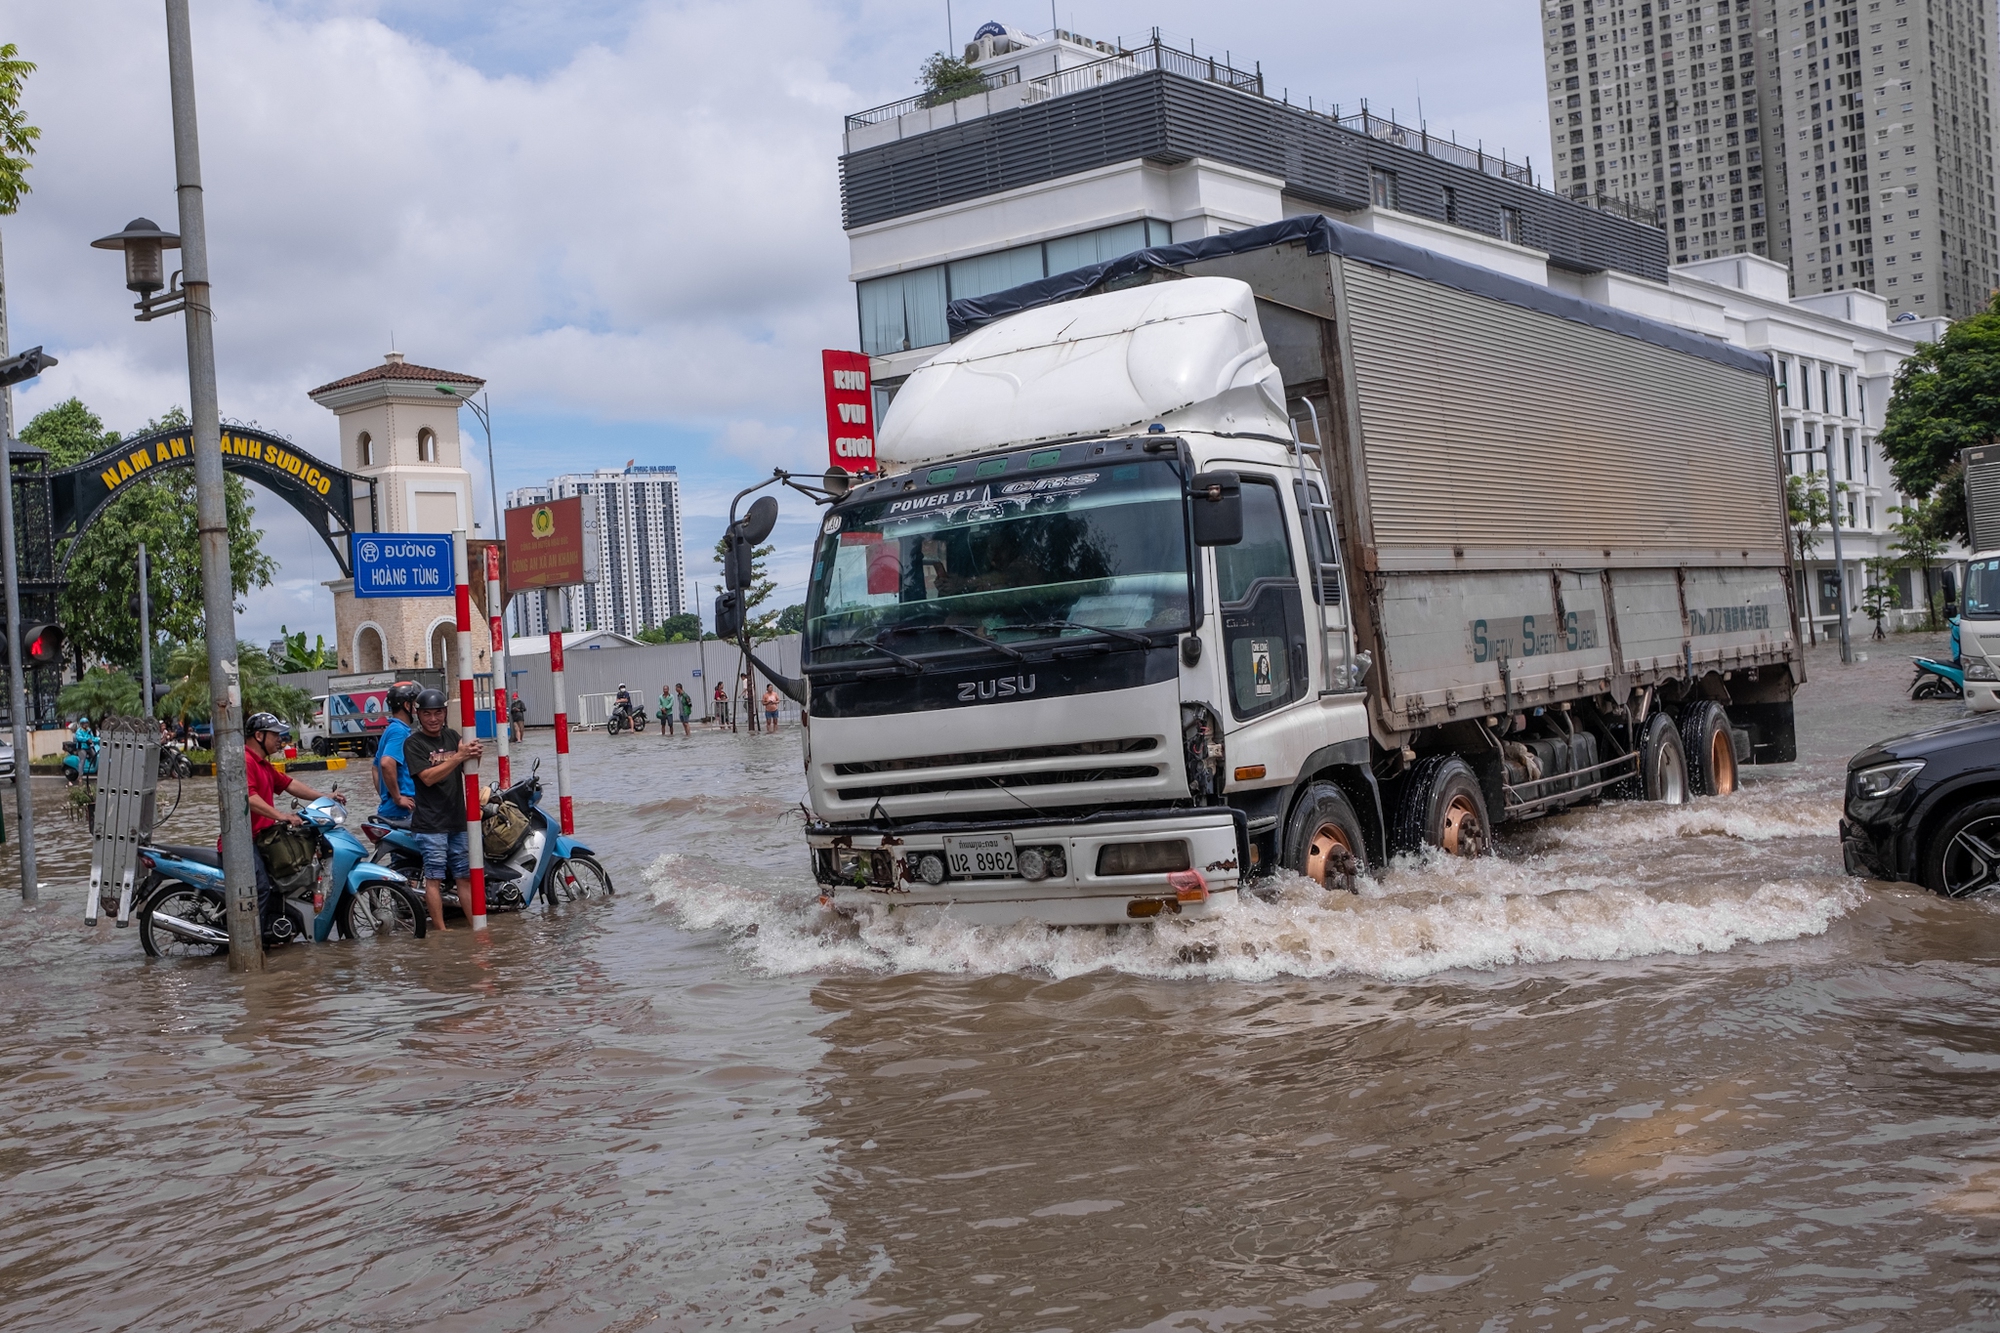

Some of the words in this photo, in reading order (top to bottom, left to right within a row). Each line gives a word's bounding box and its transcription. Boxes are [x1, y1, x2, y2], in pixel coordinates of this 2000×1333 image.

[833, 370, 866, 391] KHU
[838, 403, 866, 424] VUI
[835, 436, 873, 458] CHƠI
[100, 448, 153, 491] NAM
[156, 435, 187, 463] AN
[263, 444, 332, 495] SUDICO
[890, 494, 949, 514] POWER
[953, 489, 976, 501] BY
[384, 540, 437, 558] ĐƯỜNG
[511, 557, 528, 573] CÔNG
[529, 557, 539, 571] AN
[548, 554, 558, 569] AN
[371, 564, 407, 586] HOÀNG
[412, 564, 439, 585] TÙNG
[1522, 615, 1558, 657] SAFETY
[1565, 611, 1597, 651] SURELY
[957, 673, 1036, 702] ZUSU
[976, 851, 1016, 871] 8962
